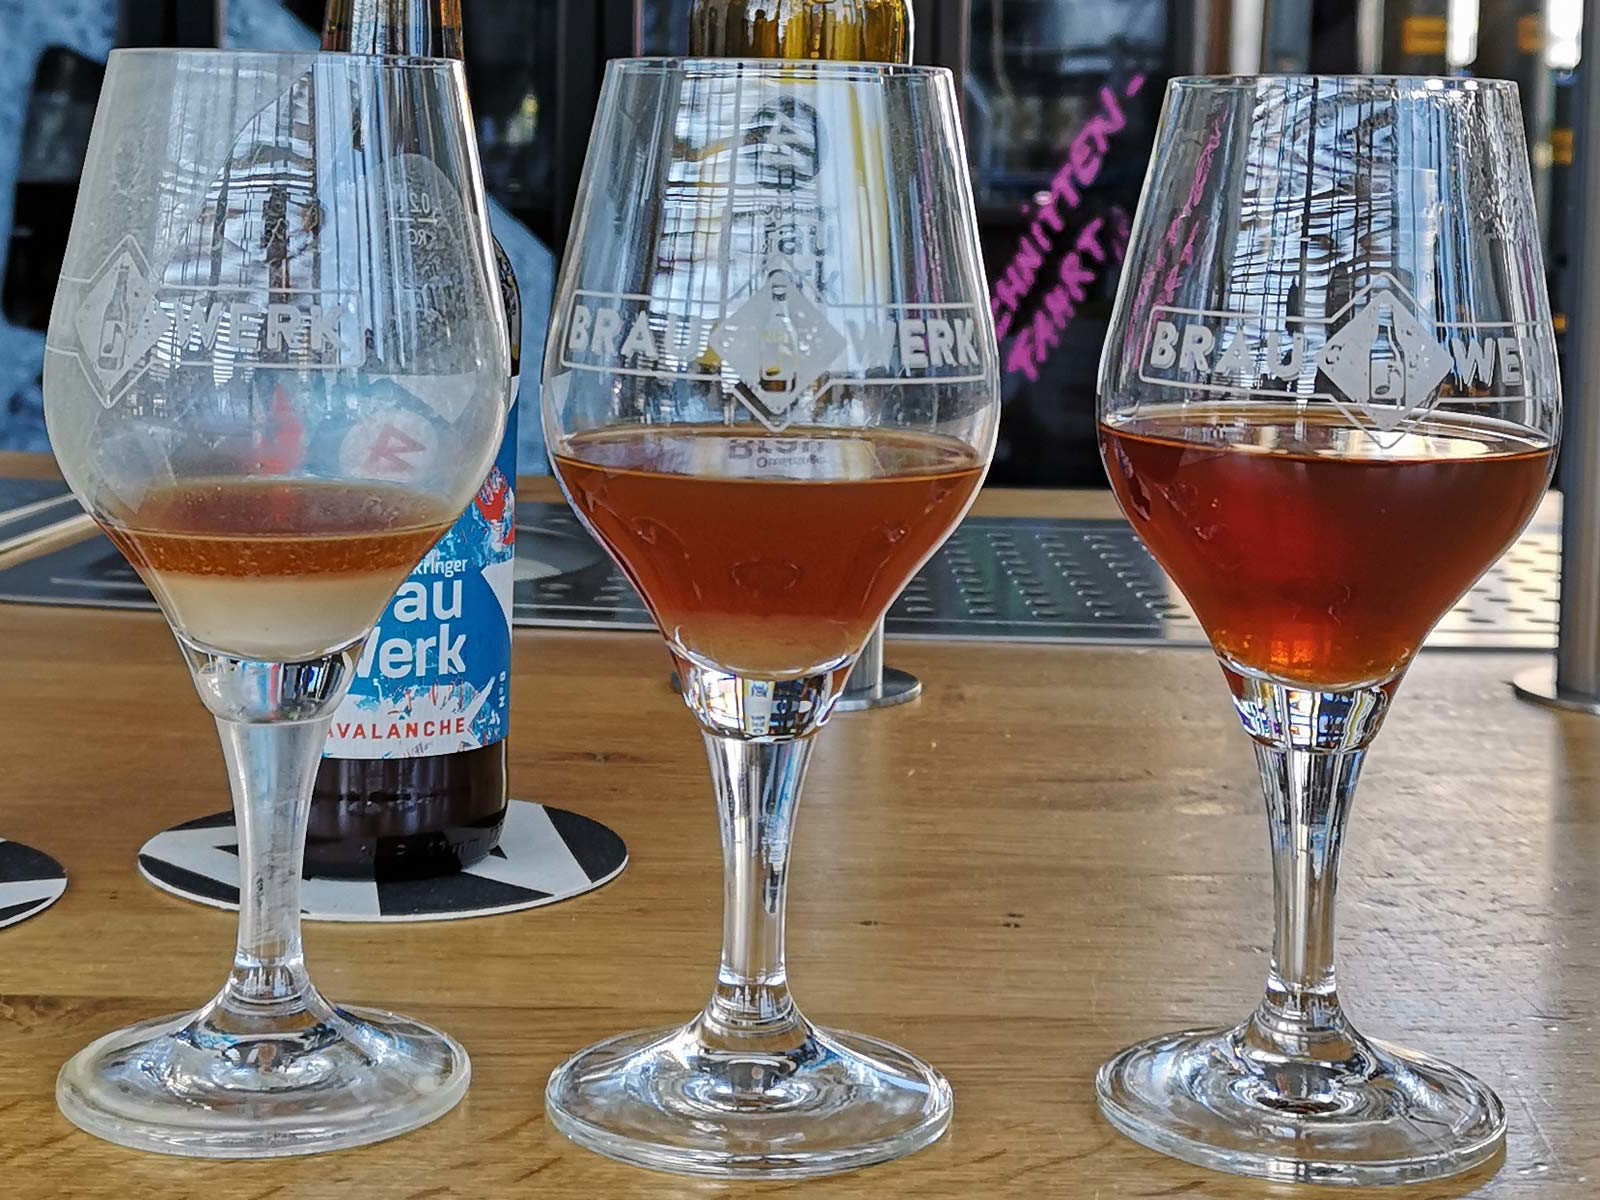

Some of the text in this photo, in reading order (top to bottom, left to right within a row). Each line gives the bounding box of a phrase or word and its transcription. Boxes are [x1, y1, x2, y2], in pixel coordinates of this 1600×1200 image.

[175, 303, 345, 353] WERK
[568, 304, 981, 374] BRAU WERK
[1150, 321, 1306, 382] BRAU
